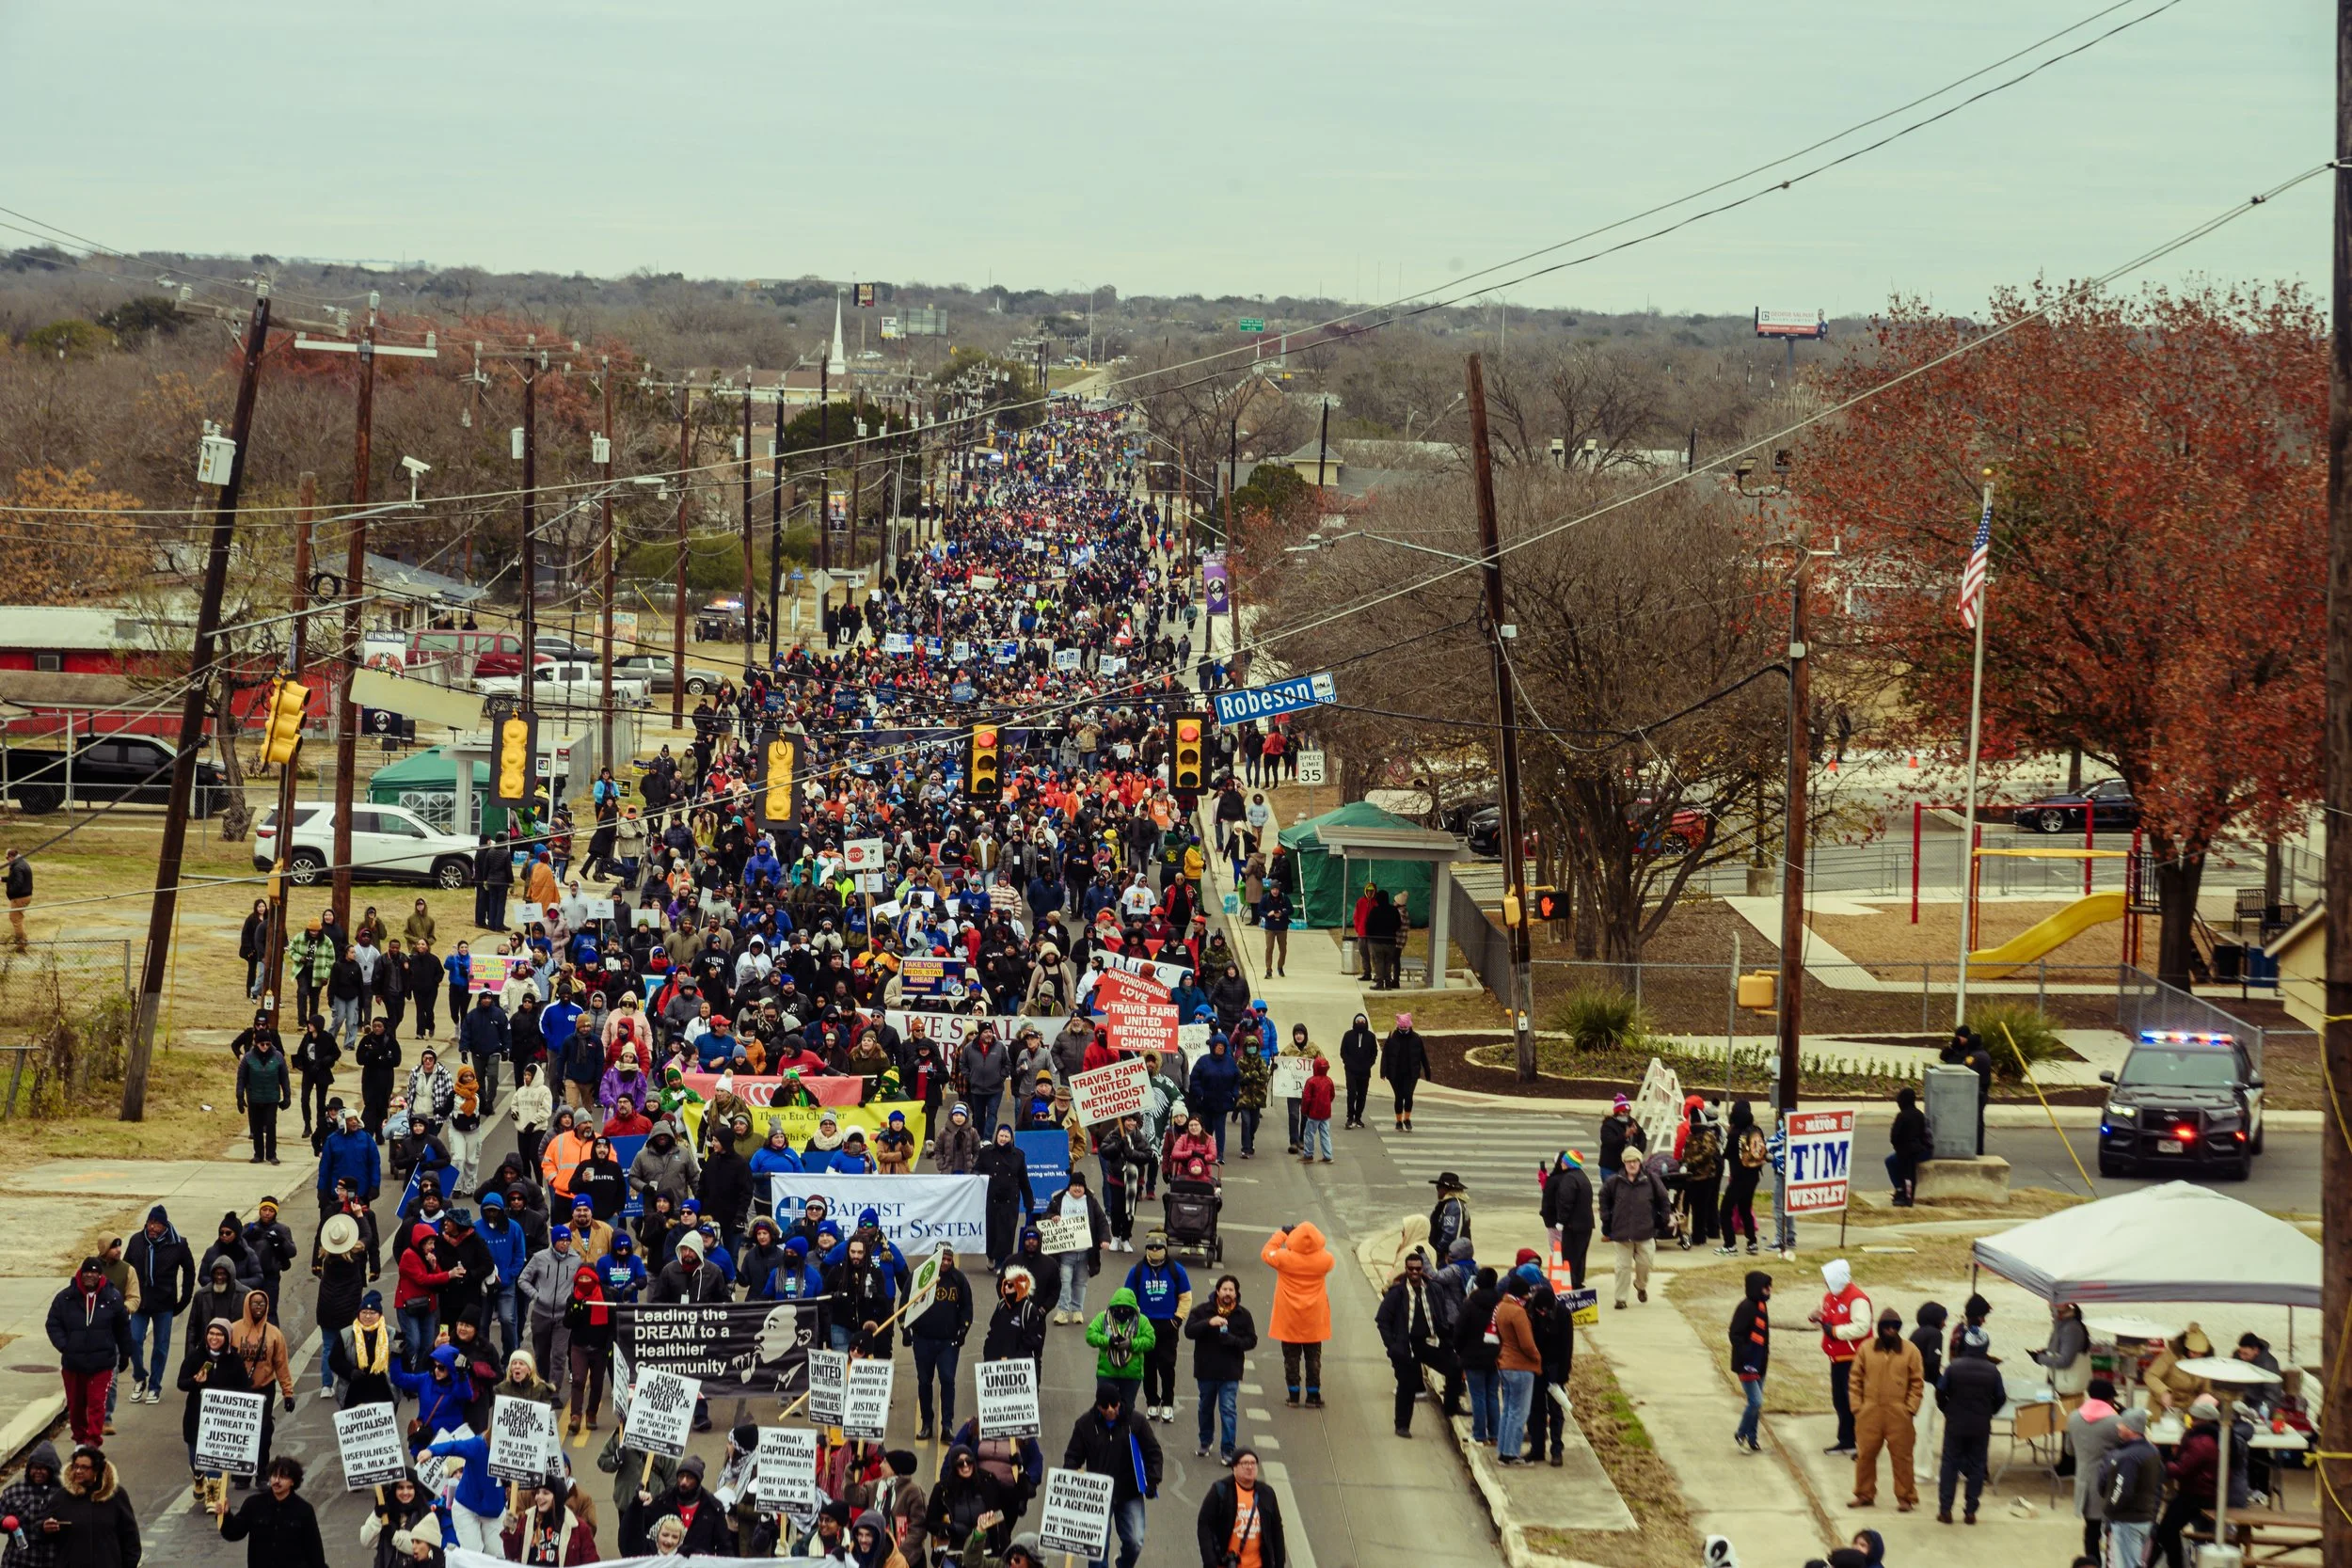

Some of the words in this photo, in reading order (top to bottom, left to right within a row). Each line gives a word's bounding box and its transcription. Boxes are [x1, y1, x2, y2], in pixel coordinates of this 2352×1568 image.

[1221, 684, 1311, 720] Robeson
[1301, 769, 1322, 782] 35
[1107, 969, 1168, 999] UNCONDITIONAL
[1111, 1004, 1147, 1016] TRAVIS
[1150, 1006, 1179, 1018] PARK
[1124, 1016, 1162, 1026] UNITED
[1112, 1025, 1173, 1038] METHODIST
[1120, 1037, 1165, 1049] CHURCH
[1072, 1071, 1111, 1089] TRAVIS
[1115, 1063, 1146, 1078] PARK
[1089, 1078, 1131, 1096] UNITED
[1081, 1085, 1146, 1110] METHODIST
[1092, 1099, 1141, 1118] CHURCH
[790, 1111, 805, 1122] Eta
[1790, 1140, 1849, 1180] TIM
[1788, 1184, 1846, 1207] WESTLEY
[1061, 1216, 1086, 1227] STEVEN
[1059, 1233, 1074, 1242] OWN
[634, 1308, 698, 1324] Leading
[703, 1309, 728, 1321] the
[634, 1325, 695, 1340] DREAM
[699, 1324, 715, 1338] to
[720, 1327, 730, 1338] a
[634, 1342, 707, 1357] Healthier
[821, 1354, 841, 1364] PEOPLE
[811, 1364, 841, 1378] UNITED
[981, 1366, 994, 1376] ¡EL
[996, 1363, 1030, 1374] PUEBLO
[657, 1373, 683, 1388] FIGHT
[821, 1378, 841, 1387] DEFEND
[850, 1376, 881, 1386] ANYWHERE
[985, 1372, 1027, 1388] UNIDO
[811, 1389, 841, 1402] IMMIGRANT
[856, 1387, 878, 1397] THREAT
[879, 1389, 886, 1398] TO
[202, 1405, 247, 1419] ANYWHERE
[248, 1412, 258, 1420] IS
[510, 1402, 533, 1413] FIGHT
[651, 1400, 673, 1413] WAR
[811, 1400, 841, 1413] FAMILIES!
[850, 1402, 882, 1412] JUSTICE
[1003, 1403, 1034, 1413] FAMILIAS
[663, 1415, 682, 1426] EVILS
[983, 1411, 1035, 1423] MIGRANTES!
[204, 1417, 211, 1425] A
[213, 1418, 244, 1430] THREAT
[245, 1422, 256, 1432] TO
[340, 1416, 393, 1436] CAPITALISM
[205, 1431, 250, 1446] JUSTICE
[342, 1437, 355, 1446] HAS
[356, 1432, 384, 1442] OUTLIVED
[385, 1428, 395, 1436] ITS
[508, 1429, 528, 1439] WAR
[652, 1430, 667, 1439] MLK
[669, 1433, 678, 1442] JR
[520, 1444, 538, 1453] EVILS
[760, 1445, 815, 1459] CAPITALISM
[368, 1459, 386, 1469] MLK
[387, 1456, 398, 1465] JR
[511, 1459, 526, 1467] MLK
[527, 1462, 536, 1470] JR
[773, 1459, 802, 1469] OUTLIVED
[1054, 1473, 1069, 1483] ¡EL
[1071, 1476, 1108, 1492] PUEBLO
[779, 1490, 796, 1499] MLK
[798, 1491, 809, 1500] JR
[1049, 1496, 1061, 1507] LA
[1064, 1498, 1104, 1515] AGENDA
[1045, 1523, 1059, 1534] DE
[1061, 1526, 1101, 1544] TRUMP!
